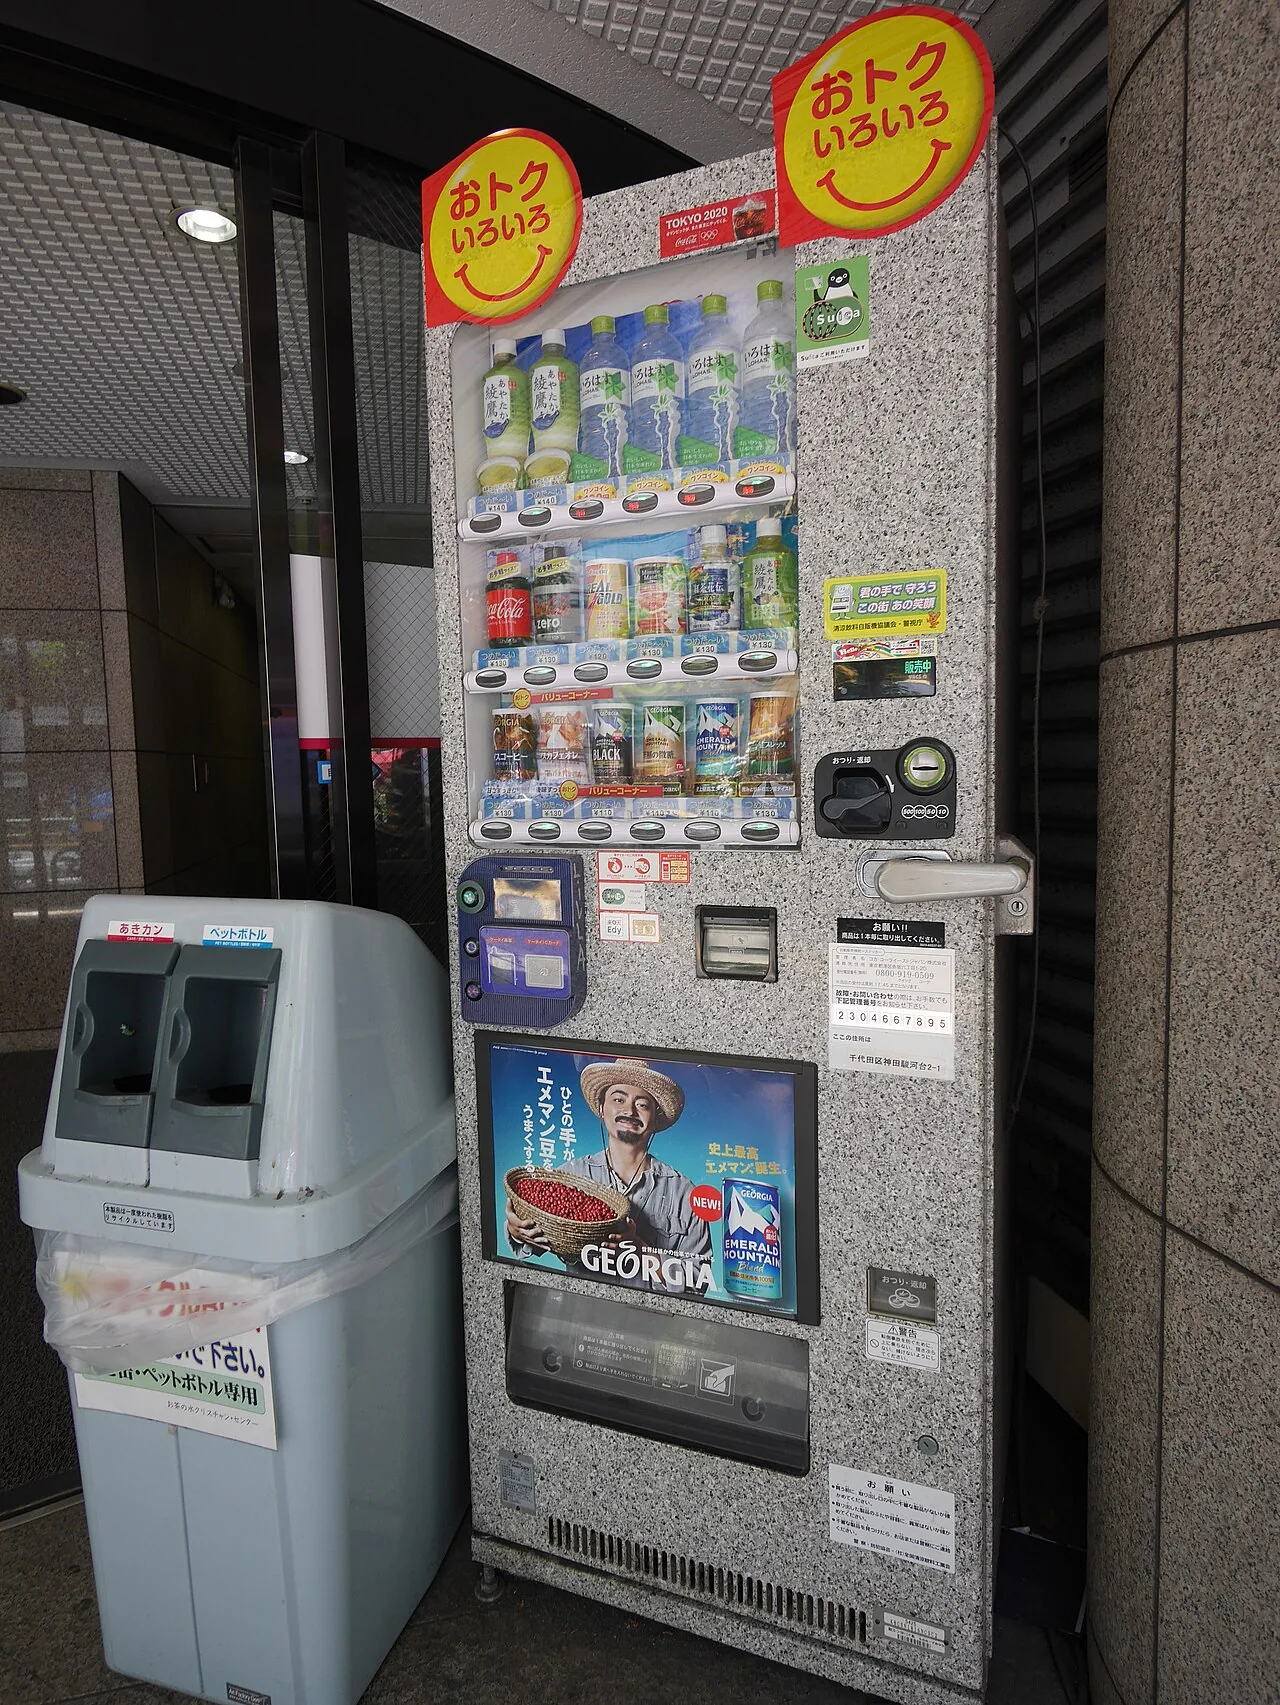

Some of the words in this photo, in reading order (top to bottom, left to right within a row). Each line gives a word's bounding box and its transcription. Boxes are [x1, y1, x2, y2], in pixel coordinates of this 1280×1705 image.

[810, 40, 947, 120] おトク
[813, 90, 950, 159] いろいろ
[450, 160, 549, 220] おトク
[665, 213, 702, 230] TOKYO
[703, 206, 728, 221] 2020
[450, 203, 550, 254] いろいろ
[816, 309, 861, 325] Suica
[744, 342, 784, 362] いろはす
[533, 375, 547, 410] 綾鷹
[485, 383, 498, 418] 綾鷹
[690, 473, 719, 481] ワンコイン
[747, 466, 777, 474] ワンコイン
[583, 485, 610, 494] ワンコイン
[635, 481, 664, 489] ワンコイン
[537, 497, 555, 505] ¥140
[859, 584, 903, 599] 君の手で
[905, 581, 937, 595] 守ろう
[596, 592, 623, 605] GOLD
[857, 601, 890, 614] この街
[891, 596, 936, 611] あの笑顔
[536, 617, 560, 630] zero
[695, 645, 715, 653] ¥130
[751, 641, 773, 649] ¥130
[904, 660, 932, 674] 販売中
[541, 691, 598, 701] バリューコーナー
[696, 736, 731, 744] EMERALD
[593, 748, 621, 761] BLACK
[832, 756, 872, 765] おつり・返却
[588, 787, 648, 796] バリューコーナー
[119, 923, 164, 936] あきカン
[210, 927, 268, 941] ペットボトル
[607, 926, 622, 934] Edy
[872, 922, 908, 933] お願い!!
[841, 932, 941, 944] 商品は1本毎に取り出してください。
[875, 969, 935, 980] 0800-919-0509
[832, 1033, 872, 1043] ここの住所は
[849, 1054, 941, 1072] 千代田区神田駿河台2-1
[536, 1066, 557, 1172] エメマン豆を
[523, 1104, 536, 1179] うまくする。
[708, 1142, 760, 1160] 史上最高
[741, 1188, 774, 1202] GEORGIA
[692, 1196, 722, 1211] NEW!
[105, 1214, 173, 1230] リサイクルしています
[725, 1239, 779, 1256] EMERALD
[580, 1240, 719, 1292] GEORGIA
[737, 1261, 765, 1273] Blend
[881, 1275, 927, 1290] おつり・返却
[899, 1326, 918, 1339] 警告
[866, 1480, 912, 1497] お願い
